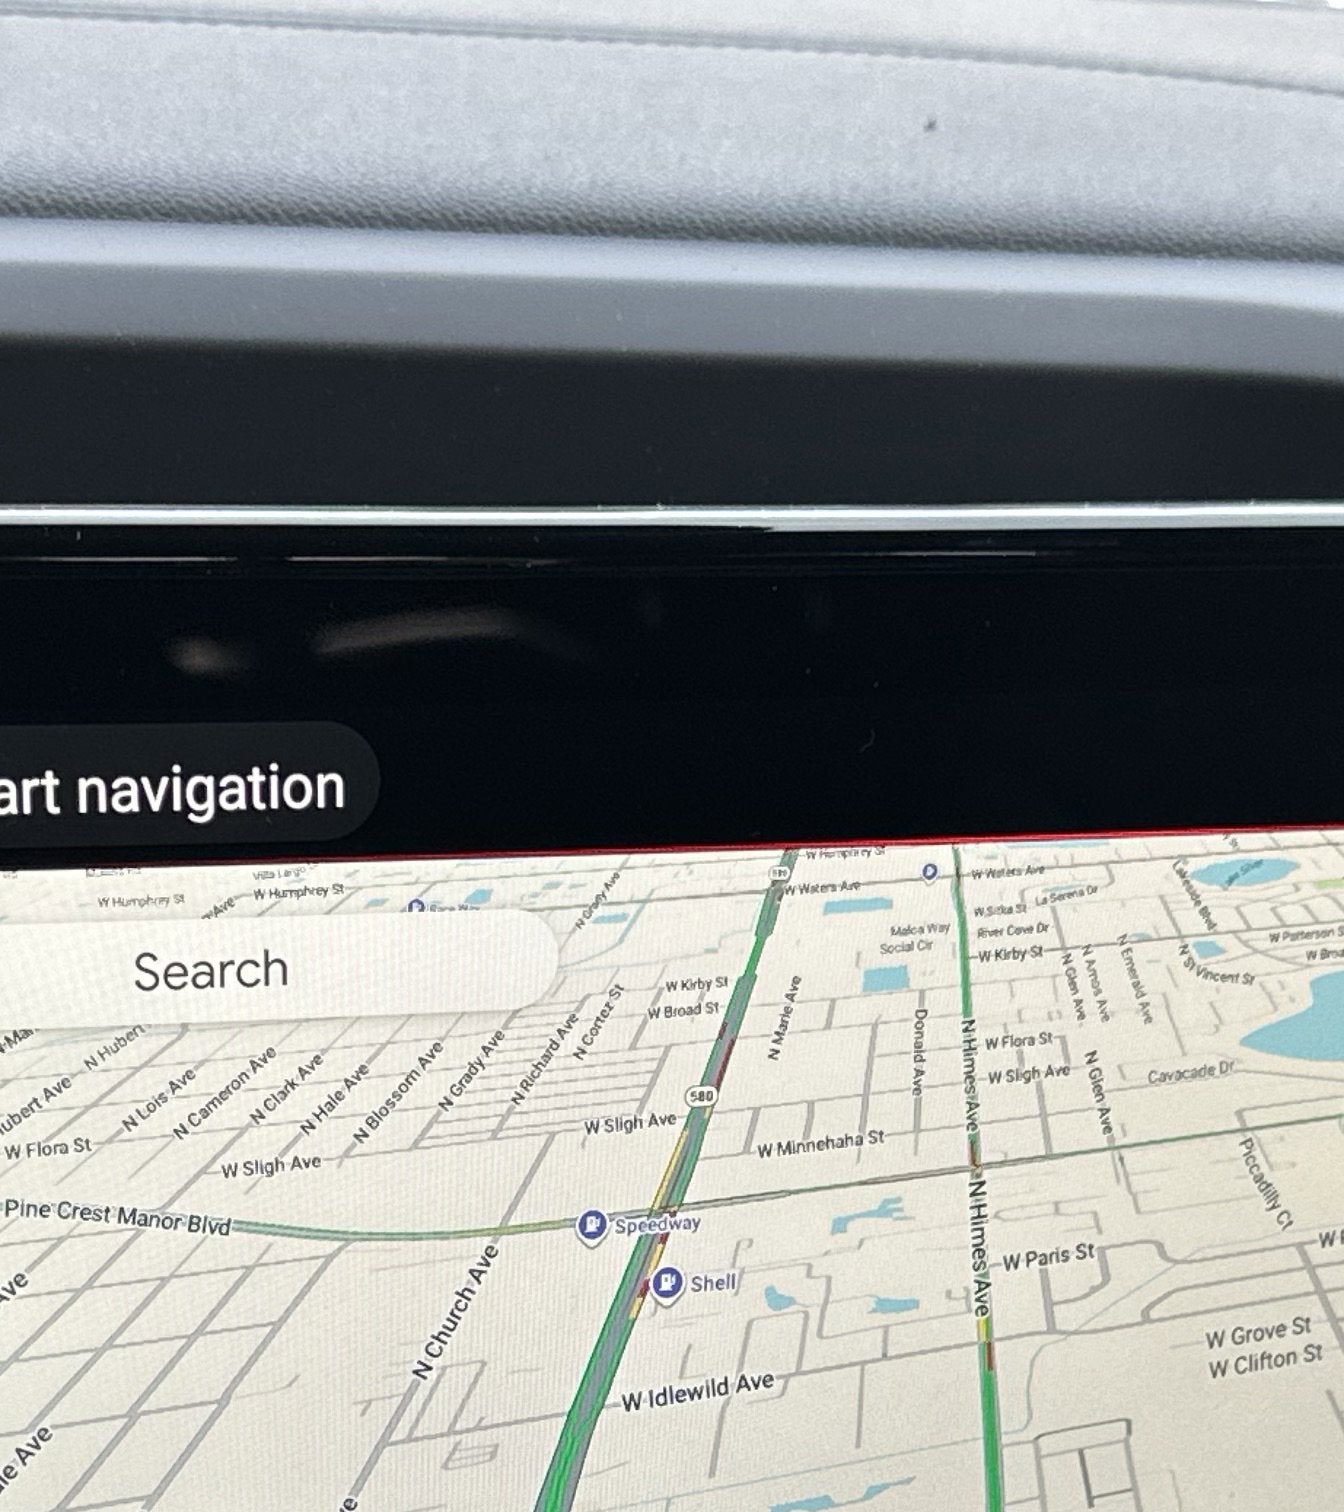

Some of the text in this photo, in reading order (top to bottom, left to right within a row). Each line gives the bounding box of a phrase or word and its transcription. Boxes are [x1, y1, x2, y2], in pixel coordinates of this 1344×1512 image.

[77, 763, 345, 825] navigation
[134, 949, 288, 991] Search
[666, 975, 728, 991] W Kirby St
[648, 1002, 719, 1019] W Broad St
[768, 976, 801, 1061] N Marie Ave
[438, 1029, 505, 1112] N Grady Ave
[511, 1013, 579, 1106] N Richard Ave
[912, 1009, 928, 1096] Donald Ave
[40, 1076, 72, 1107] Ave
[250, 1052, 324, 1125] N Clark Ave
[353, 1040, 444, 1144] N Blossom Ave
[962, 1020, 978, 1132] N Himes Ave
[122, 1068, 197, 1132] N Lois Ave
[300, 1062, 370, 1136] N Hale Ave
[4, 1138, 92, 1159] W Flora St
[758, 1130, 884, 1158] W Minnehaha St
[1239, 1137, 1294, 1231] Piccadilly Ct
[6, 1199, 231, 1236] Pine Crest Manor Blvd
[615, 1217, 700, 1234] Speedway
[969, 1181, 992, 1318] N Himes Ave
[1003, 1244, 1094, 1270] W Paris St
[691, 1273, 736, 1292] Shell
[413, 1244, 498, 1380] N Church Ave
[1206, 1317, 1311, 1349] W Grove St
[1209, 1344, 1322, 1378] W Clifton St
[622, 1374, 774, 1412] W Idlewild Ave
[14, 1426, 53, 1466] Ave
